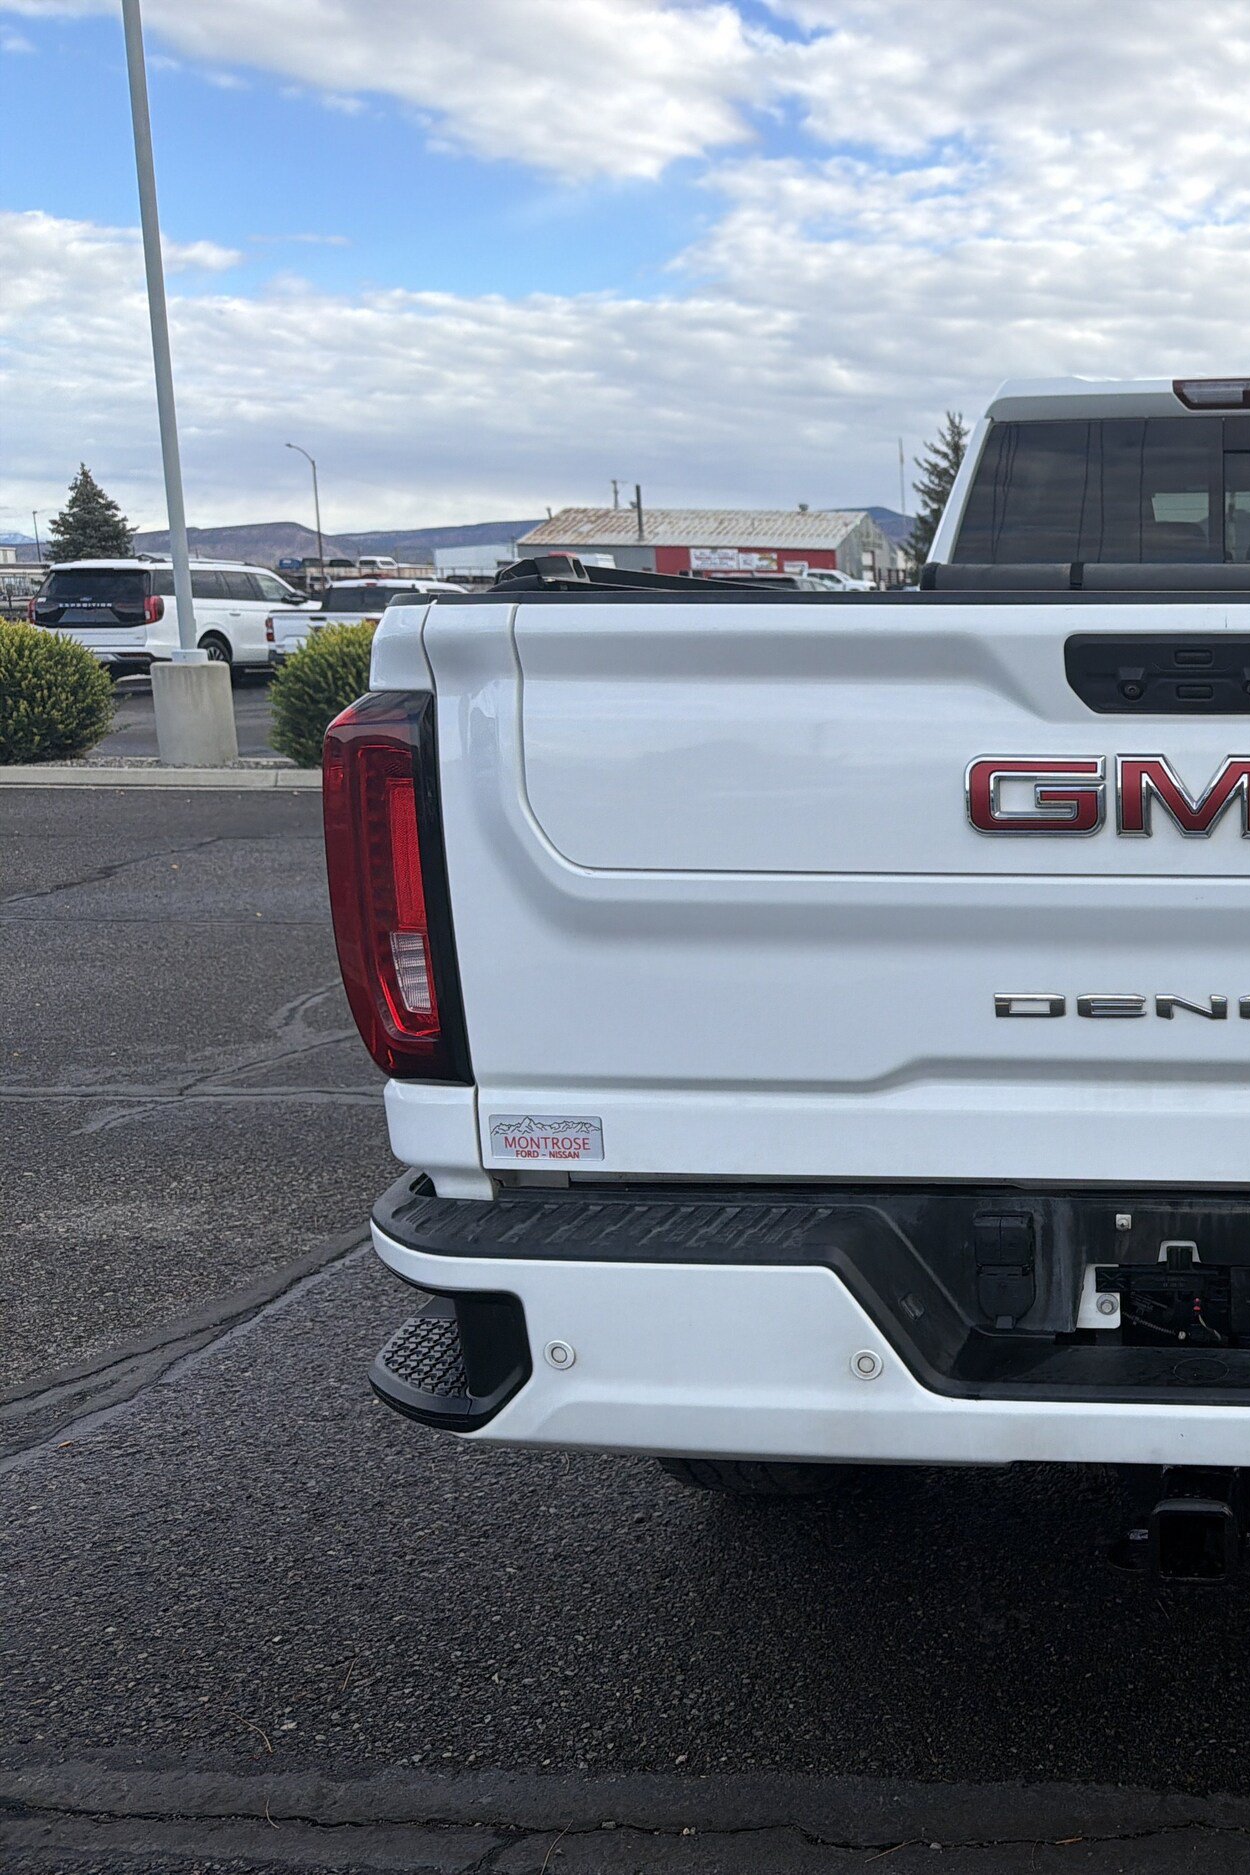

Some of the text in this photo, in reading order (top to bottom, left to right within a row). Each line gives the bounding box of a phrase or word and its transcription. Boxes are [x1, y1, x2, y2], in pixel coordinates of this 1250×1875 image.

[503, 1136, 591, 1150] MONTROSE
[515, 1149, 539, 1158] FORD
[549, 1150, 580, 1159] NISSAN
